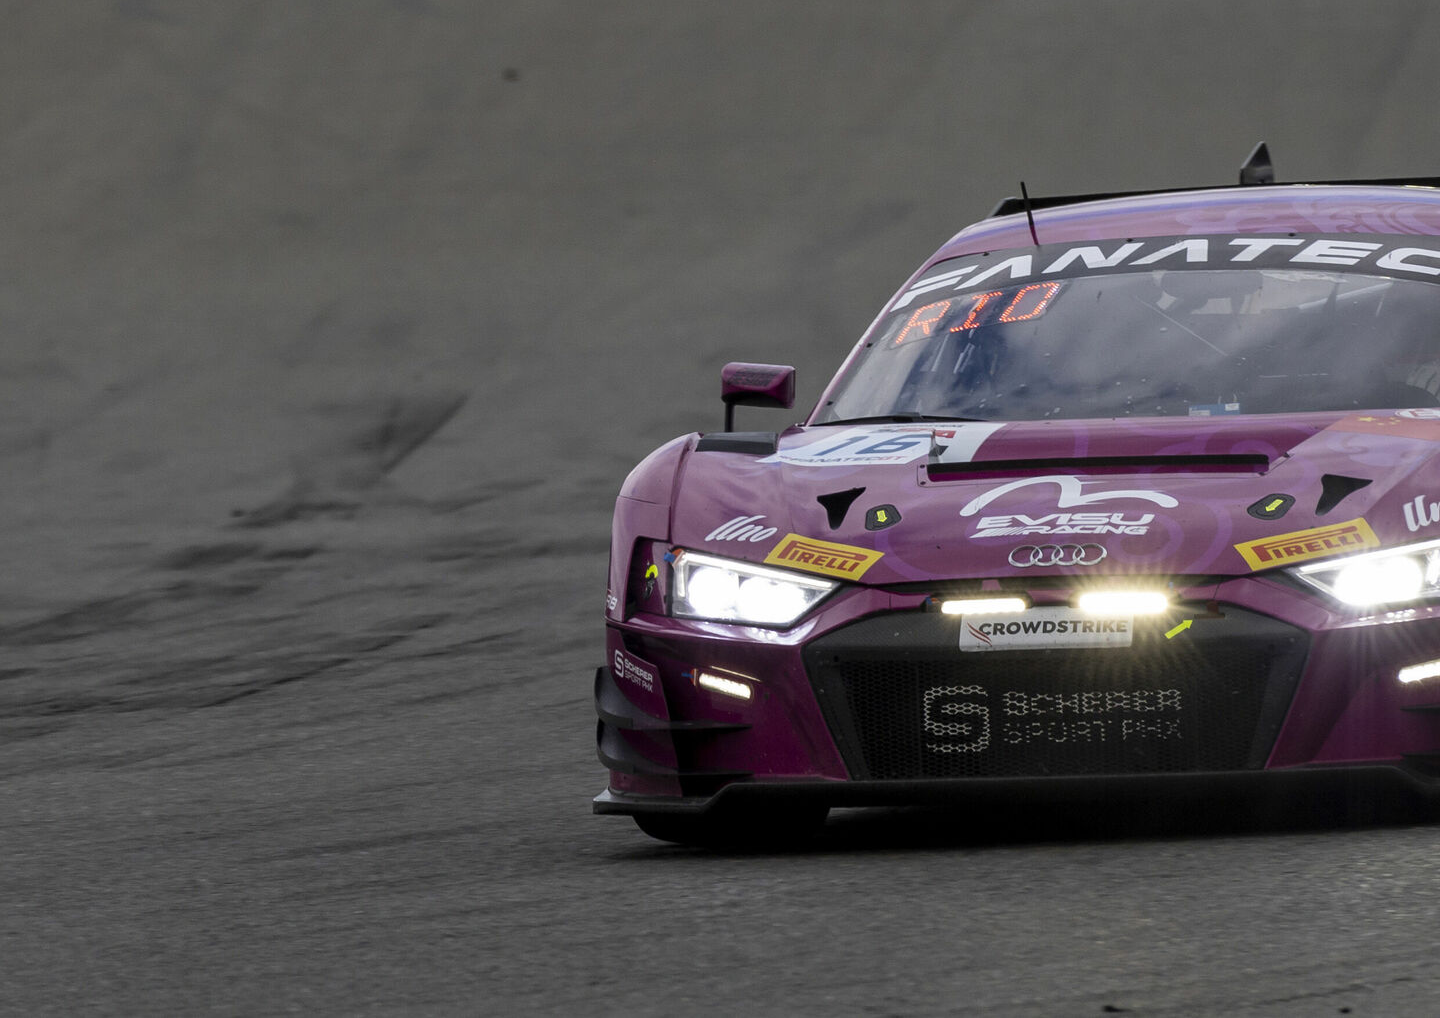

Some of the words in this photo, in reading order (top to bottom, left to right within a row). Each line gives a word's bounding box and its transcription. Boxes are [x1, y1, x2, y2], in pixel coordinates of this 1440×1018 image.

[814, 433, 932, 457] 16
[975, 512, 1156, 529] EVISU
[1022, 525, 1149, 535] RACING
[1251, 525, 1364, 563] PIRELLI
[777, 540, 869, 572] PIRELLI
[978, 619, 1129, 636] CROWDSTRIKE
[624, 659, 653, 682] SCHERER
